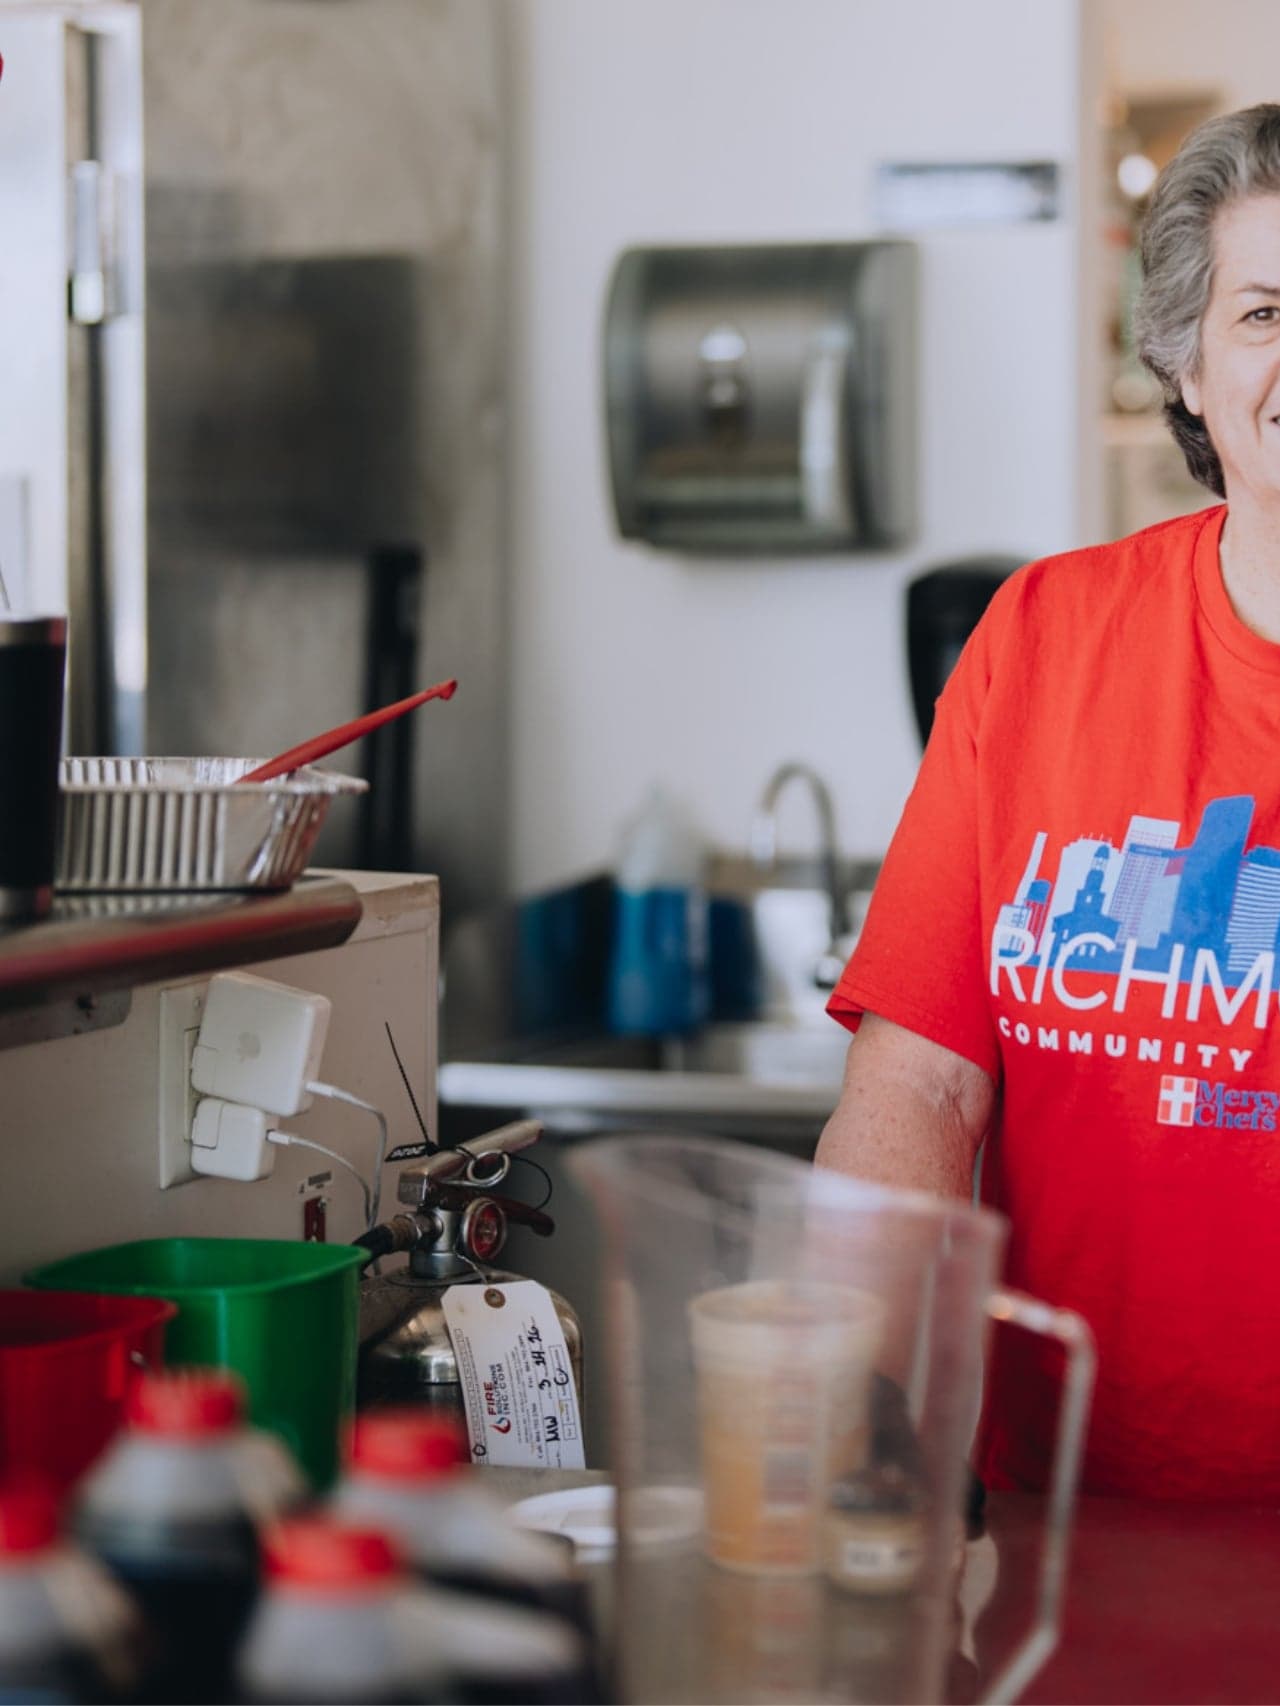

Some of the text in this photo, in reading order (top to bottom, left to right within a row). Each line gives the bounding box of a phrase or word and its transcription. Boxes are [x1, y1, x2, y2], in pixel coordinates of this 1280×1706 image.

[998, 1016, 1253, 1072] COMMUNITY
[1193, 1103, 1277, 1132] Chefs
[484, 1381, 497, 1416] FIRE
